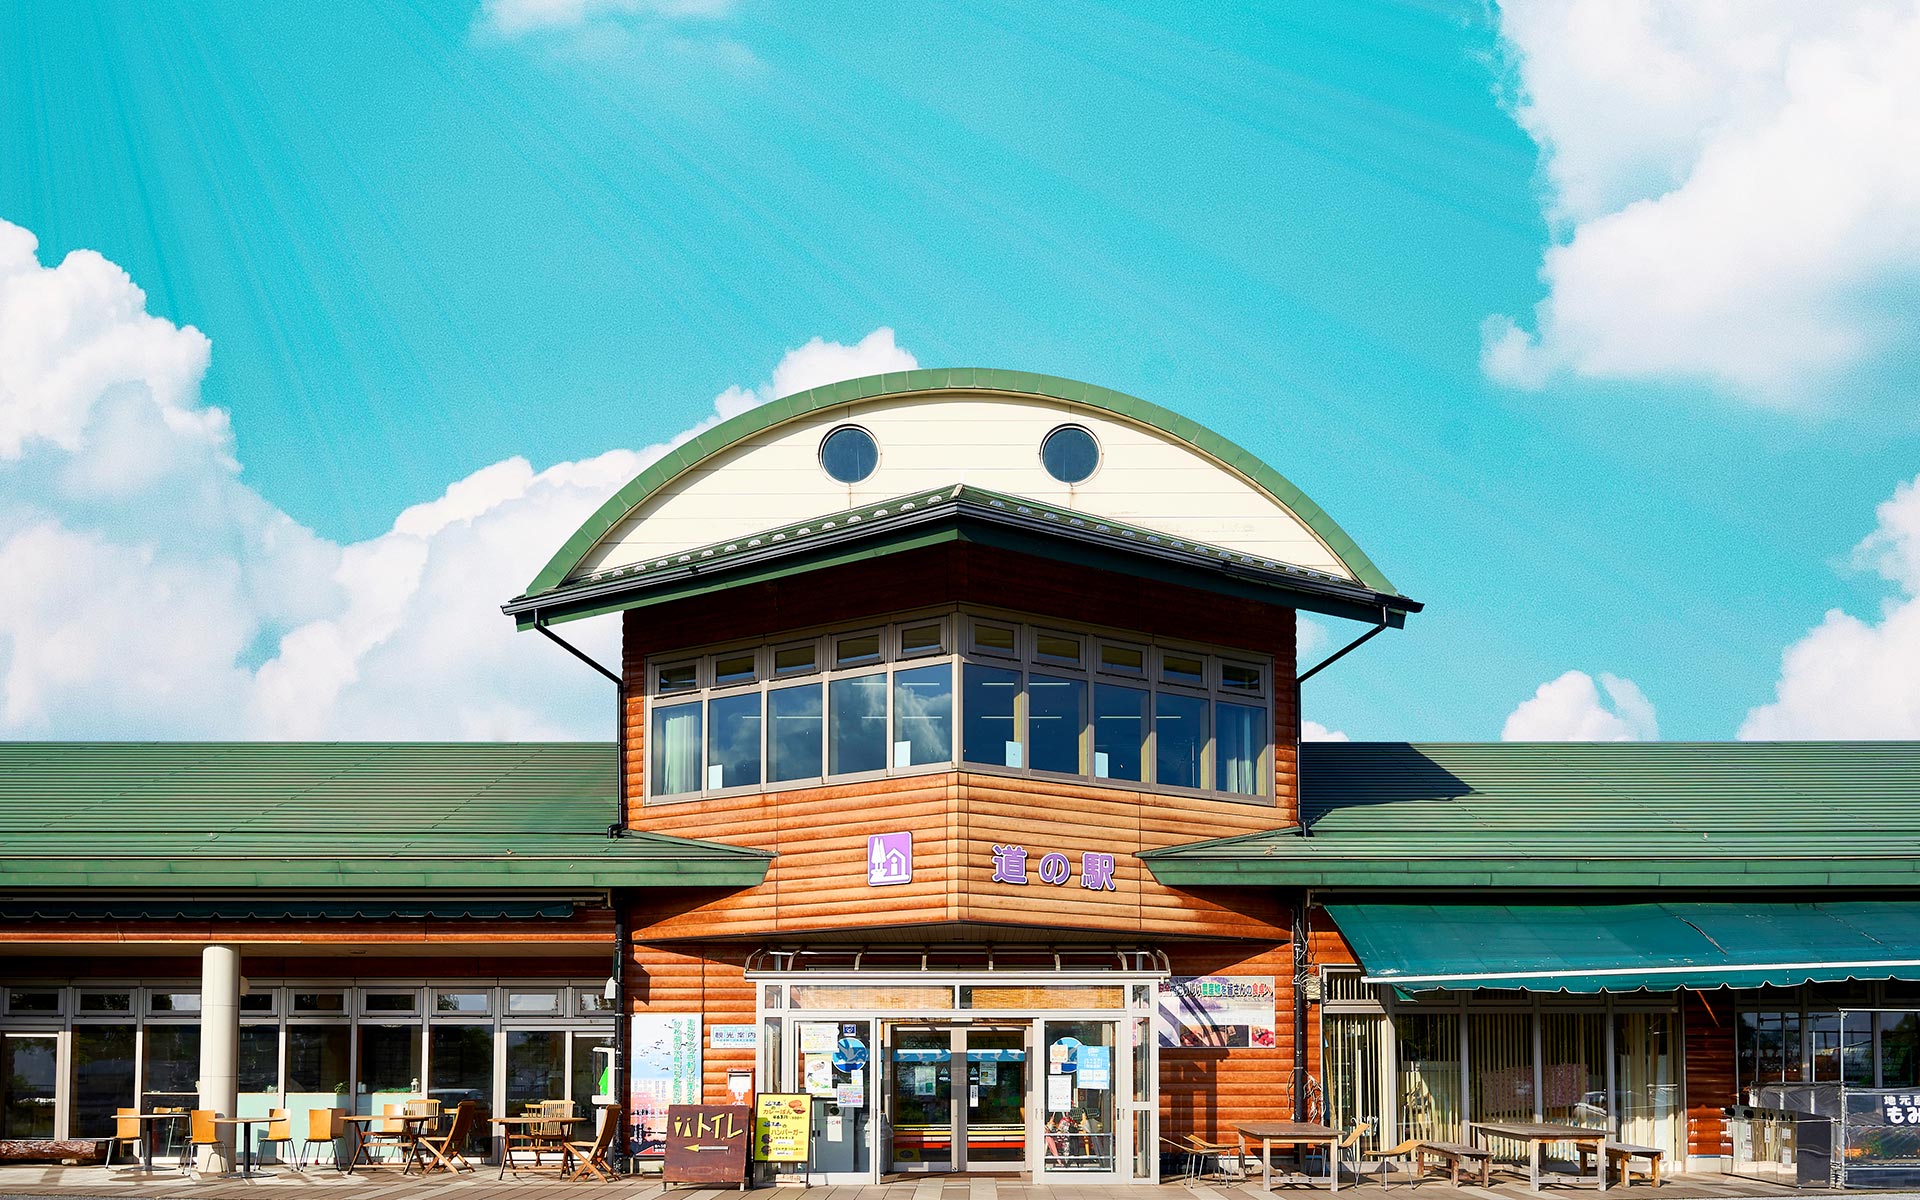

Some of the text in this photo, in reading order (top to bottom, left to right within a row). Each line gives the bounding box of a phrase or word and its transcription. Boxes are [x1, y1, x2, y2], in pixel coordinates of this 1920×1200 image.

[992, 844, 1116, 891] 道の駅
[697, 1113, 744, 1139] トイレ
